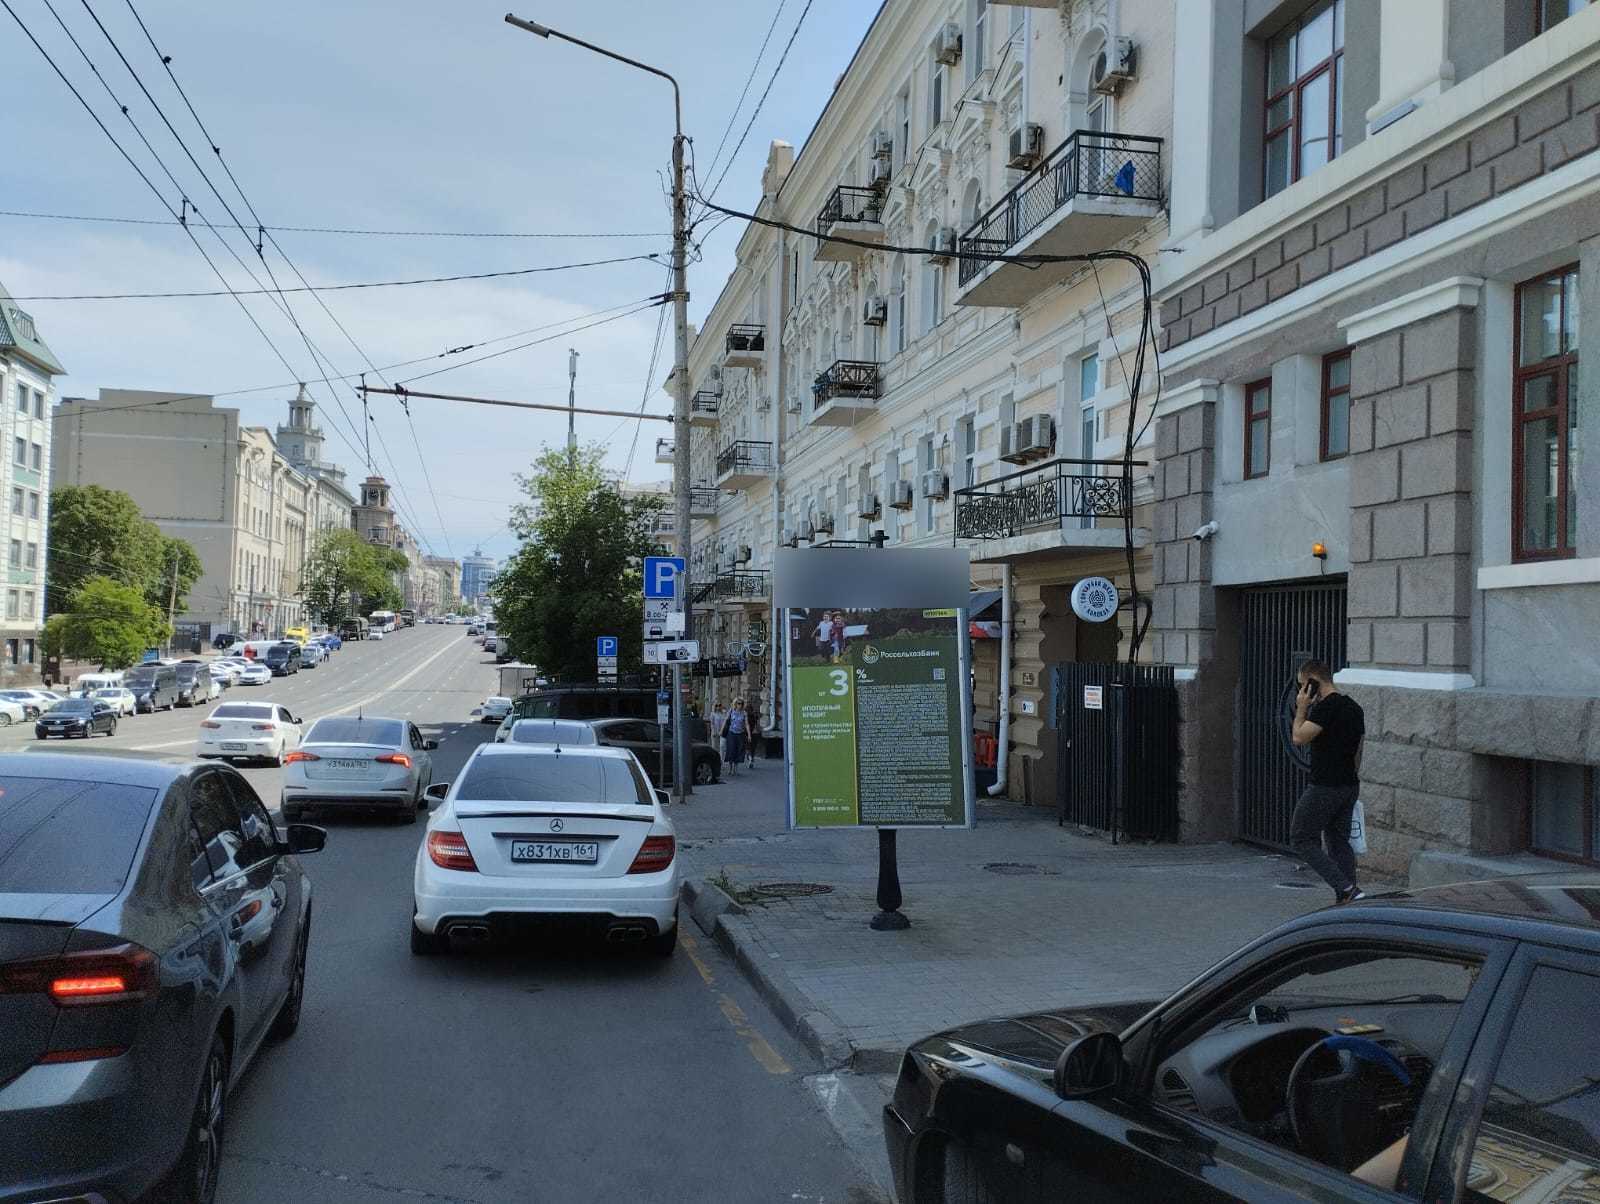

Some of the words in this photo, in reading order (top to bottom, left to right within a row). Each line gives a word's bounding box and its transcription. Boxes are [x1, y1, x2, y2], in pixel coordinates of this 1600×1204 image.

[655, 562, 679, 593] P
[602, 639, 614, 655] P
[829, 668, 849, 697] 3
[856, 668, 867, 679] %
[518, 844, 570, 859] Х831ХВ
[573, 844, 594, 855] 161
